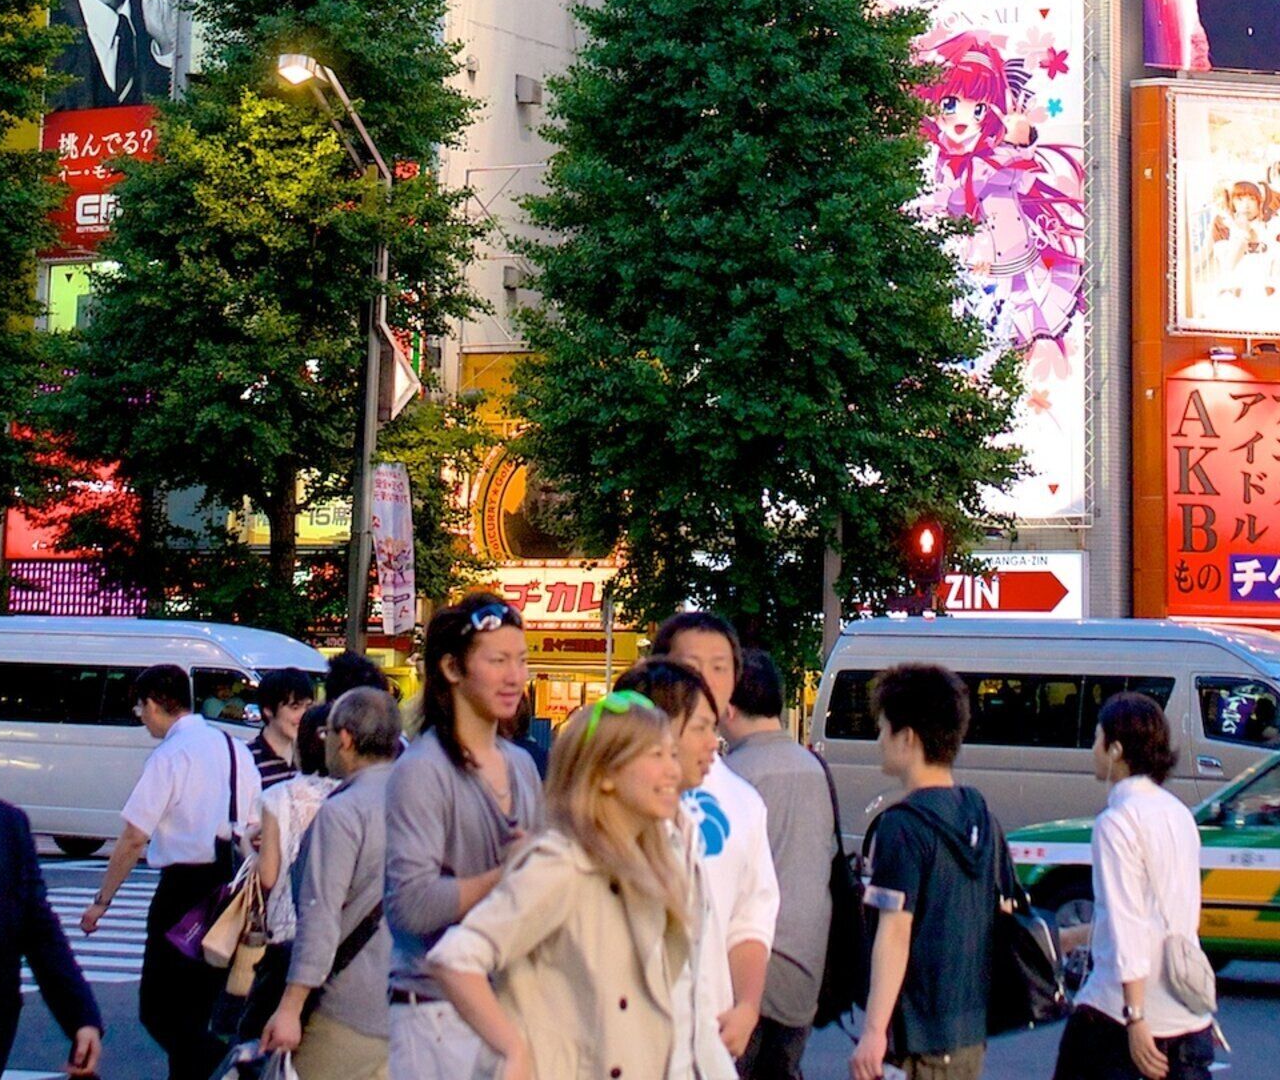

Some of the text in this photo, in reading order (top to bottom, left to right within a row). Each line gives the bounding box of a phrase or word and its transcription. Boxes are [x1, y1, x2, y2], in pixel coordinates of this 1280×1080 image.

[58, 128, 153, 161] 挑んでる?
[1228, 391, 1269, 545] アイドル
[945, 575, 1001, 610] ZIN
